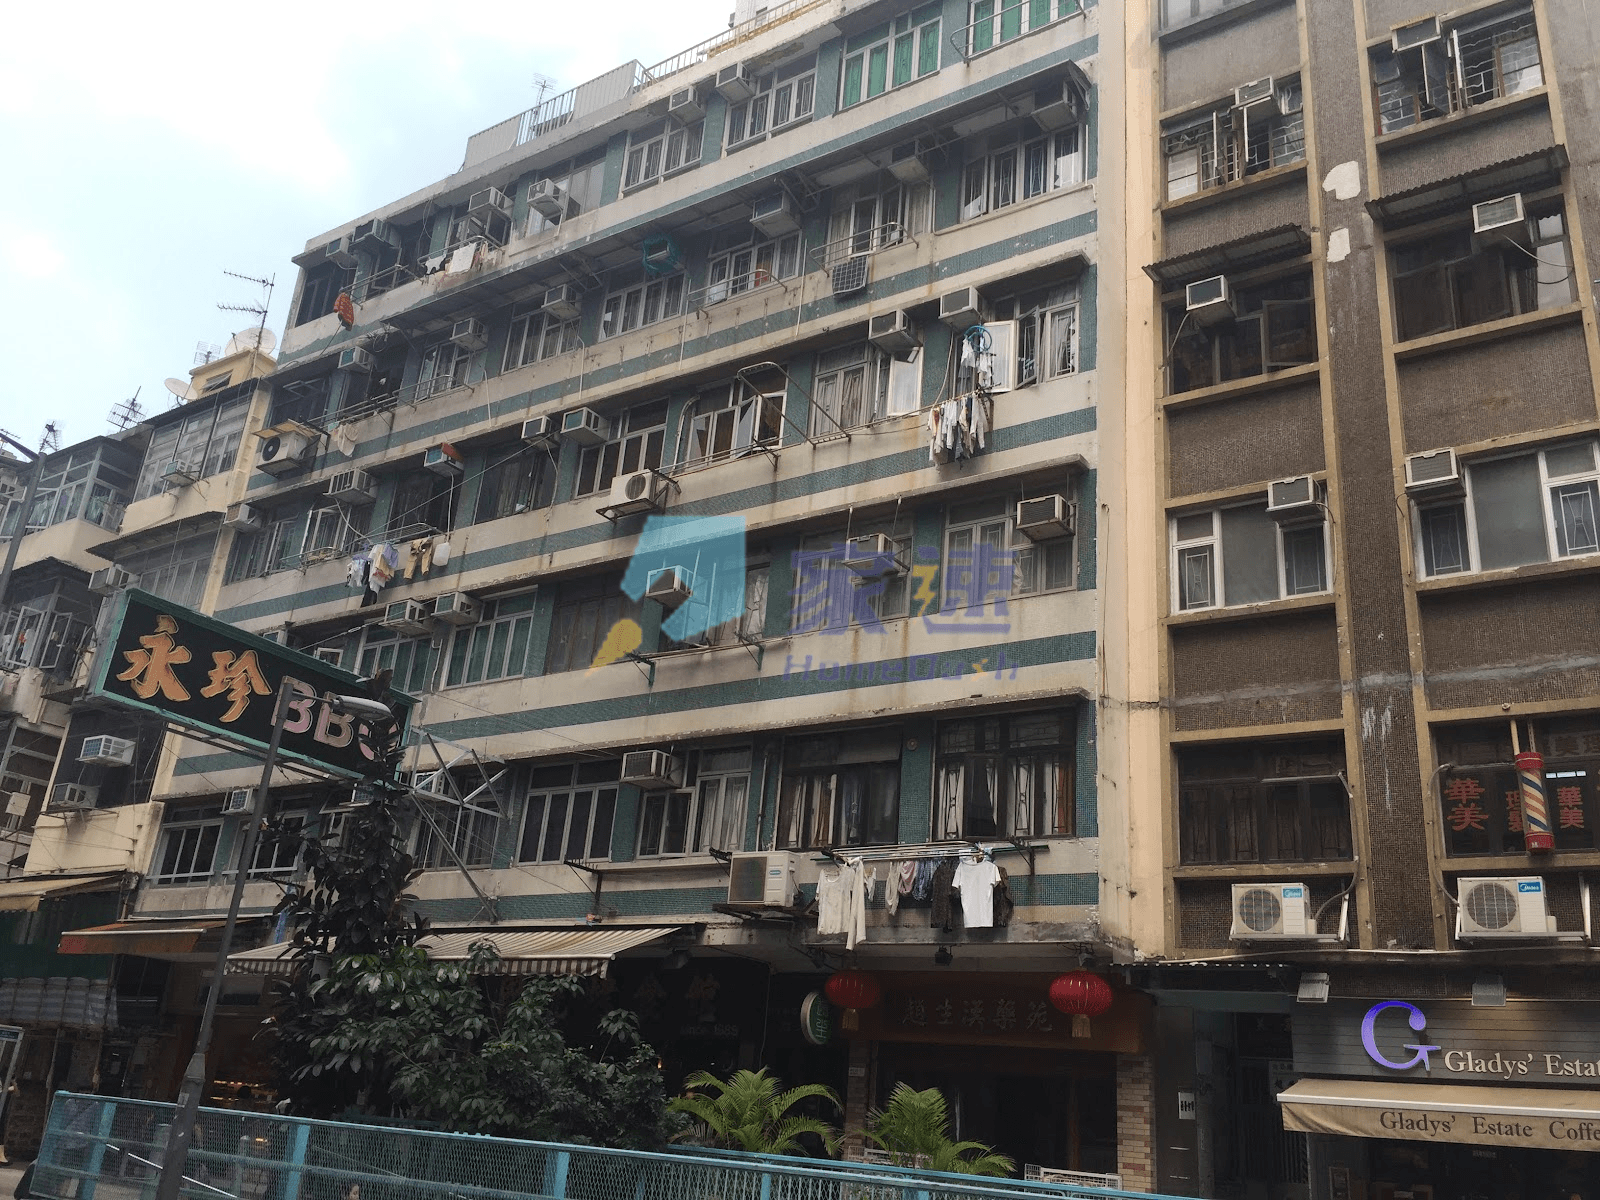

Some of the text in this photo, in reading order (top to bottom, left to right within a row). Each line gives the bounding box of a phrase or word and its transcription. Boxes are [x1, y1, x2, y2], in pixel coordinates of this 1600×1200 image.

[116, 614, 272, 723] 永珍
[1444, 778, 1489, 832] 華美
[1557, 786, 1585, 829] 華美
[1361, 1000, 1442, 1072] G
[1472, 1116, 1533, 1137] Estate
